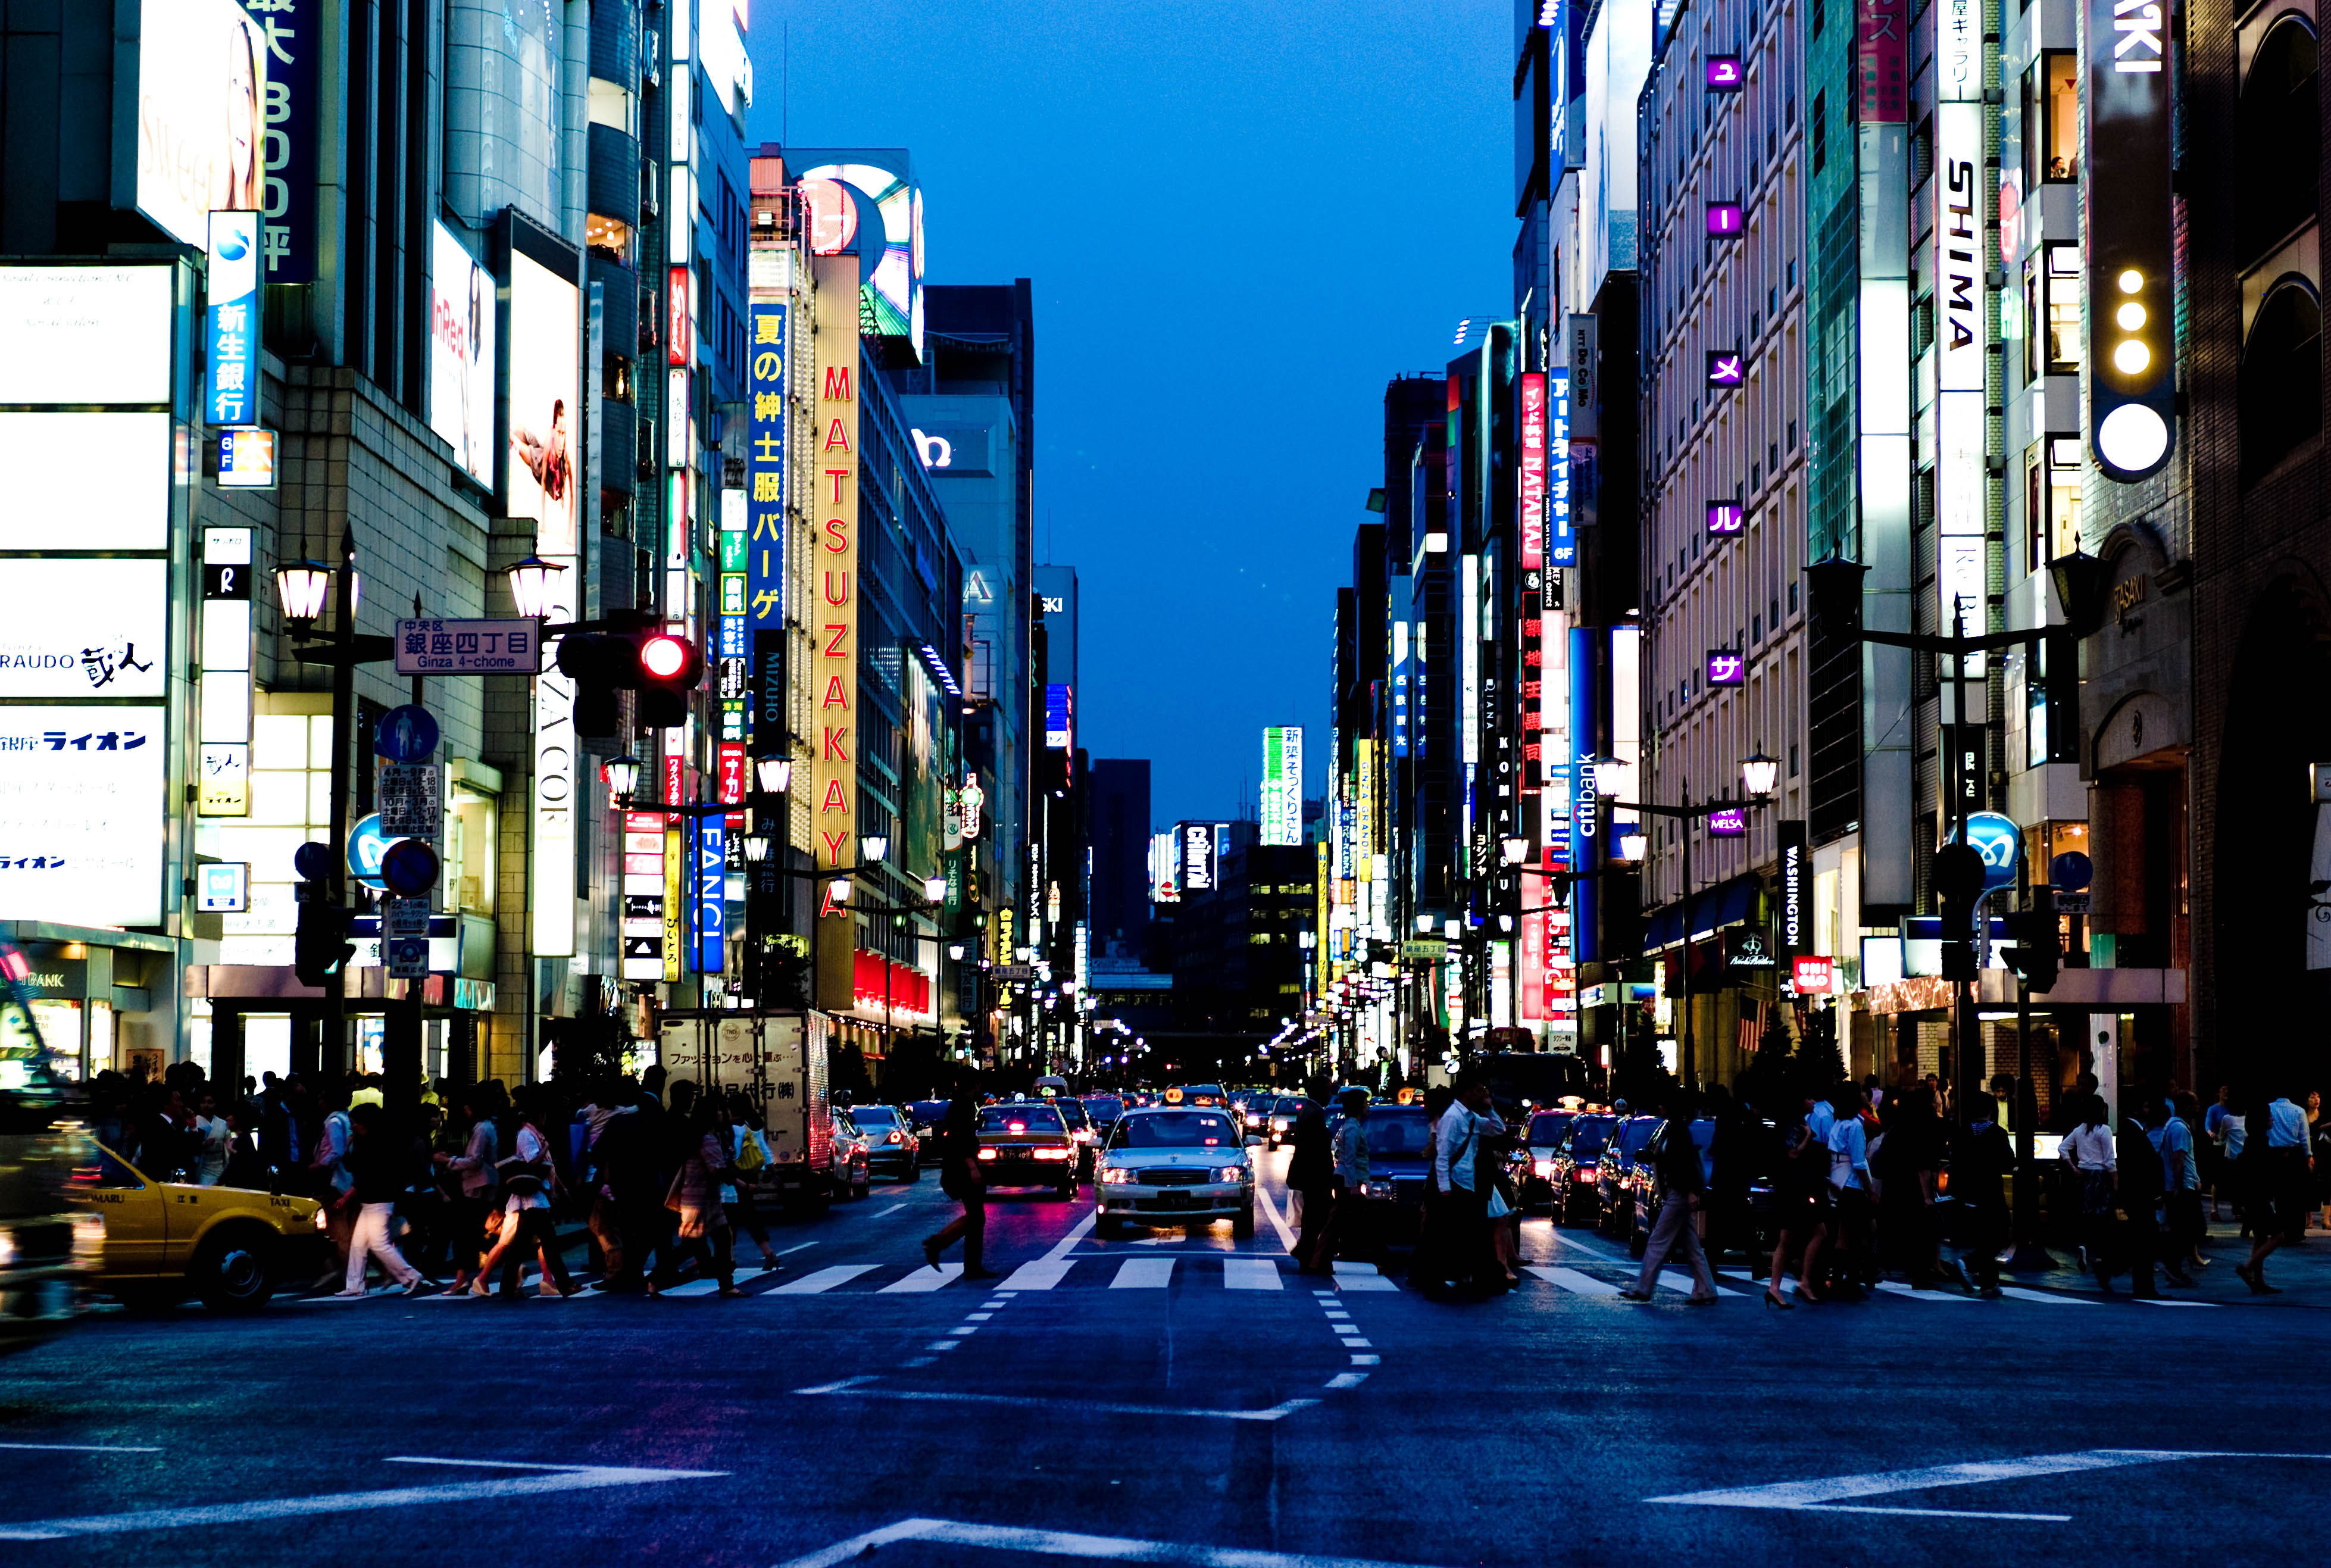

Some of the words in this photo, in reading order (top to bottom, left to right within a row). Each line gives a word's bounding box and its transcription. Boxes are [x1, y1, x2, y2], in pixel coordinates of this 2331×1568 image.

[1867, 0, 1901, 42] ズ
[1949, 157, 1973, 352] SHIMA
[431, 288, 464, 359] InRed
[215, 304, 246, 420] 新生銀行
[1525, 388, 1542, 448] インド料理
[751, 314, 783, 620] 夏の紳士服バーゲ
[1525, 457, 1542, 554] NATARAJ
[1554, 548, 1573, 559] 6F
[405, 620, 443, 631] 中央区
[2115, 573, 2146, 625] TASAKI
[405, 632, 528, 655] 銀座四丁目
[418, 655, 453, 668] Ginza
[459, 655, 515, 667] 4-chome
[820, 366, 851, 918] MATSUZAKAYA
[766, 652, 779, 721] MIZUHO
[540, 746, 569, 841] COR
[1286, 729, 1299, 844] 新築そっくりさん
[1576, 753, 1595, 837] citibank
[1711, 819, 1743, 829] MELSA
[0, 856, 65, 869] ライオン
[948, 860, 957, 905] りそな銀行
[1787, 845, 1798, 946] WASHINGTON
[1798, 963, 1827, 974] UNI
[1798, 974, 1829, 986] QLO
[270, 1198, 290, 1208] TAXI
